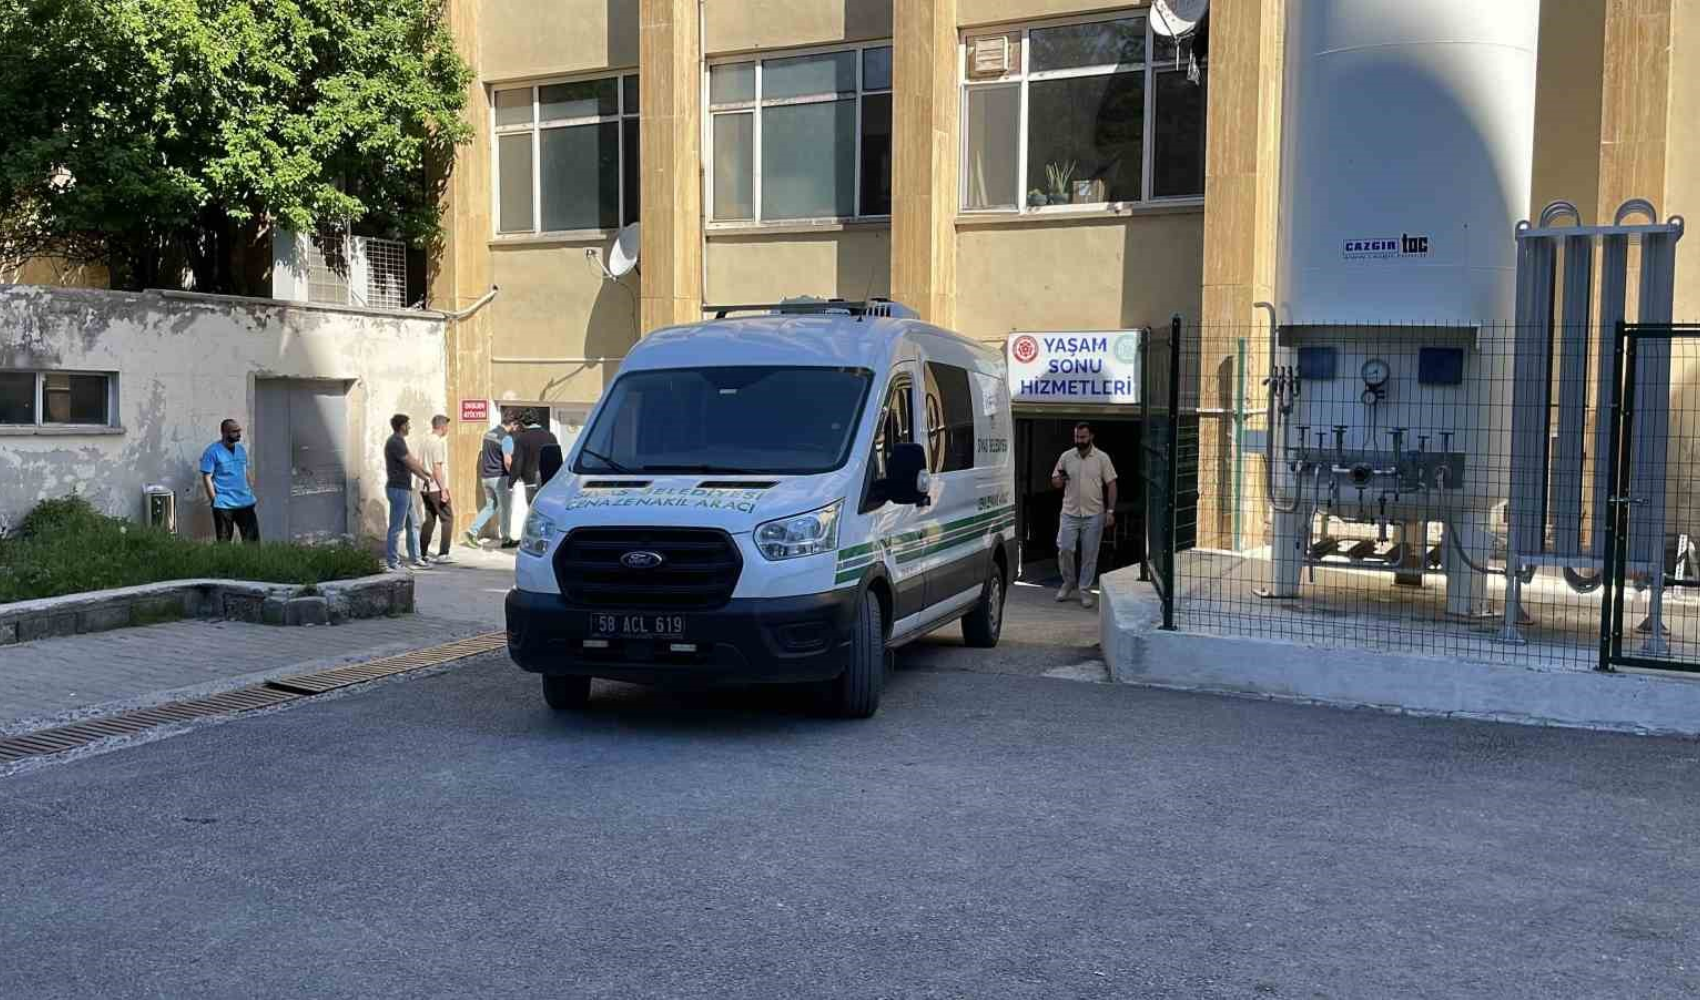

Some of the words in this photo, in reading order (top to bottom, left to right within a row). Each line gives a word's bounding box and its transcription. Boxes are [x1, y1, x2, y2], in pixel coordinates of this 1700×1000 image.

[1043, 337, 1107, 357] YAŞAM
[1048, 359, 1102, 374] SONU
[1020, 376, 1132, 395] HİZMETLERİ
[628, 553, 652, 568] Ford
[599, 616, 615, 632] 58
[623, 616, 648, 632] ACL
[655, 616, 682, 633] 619
